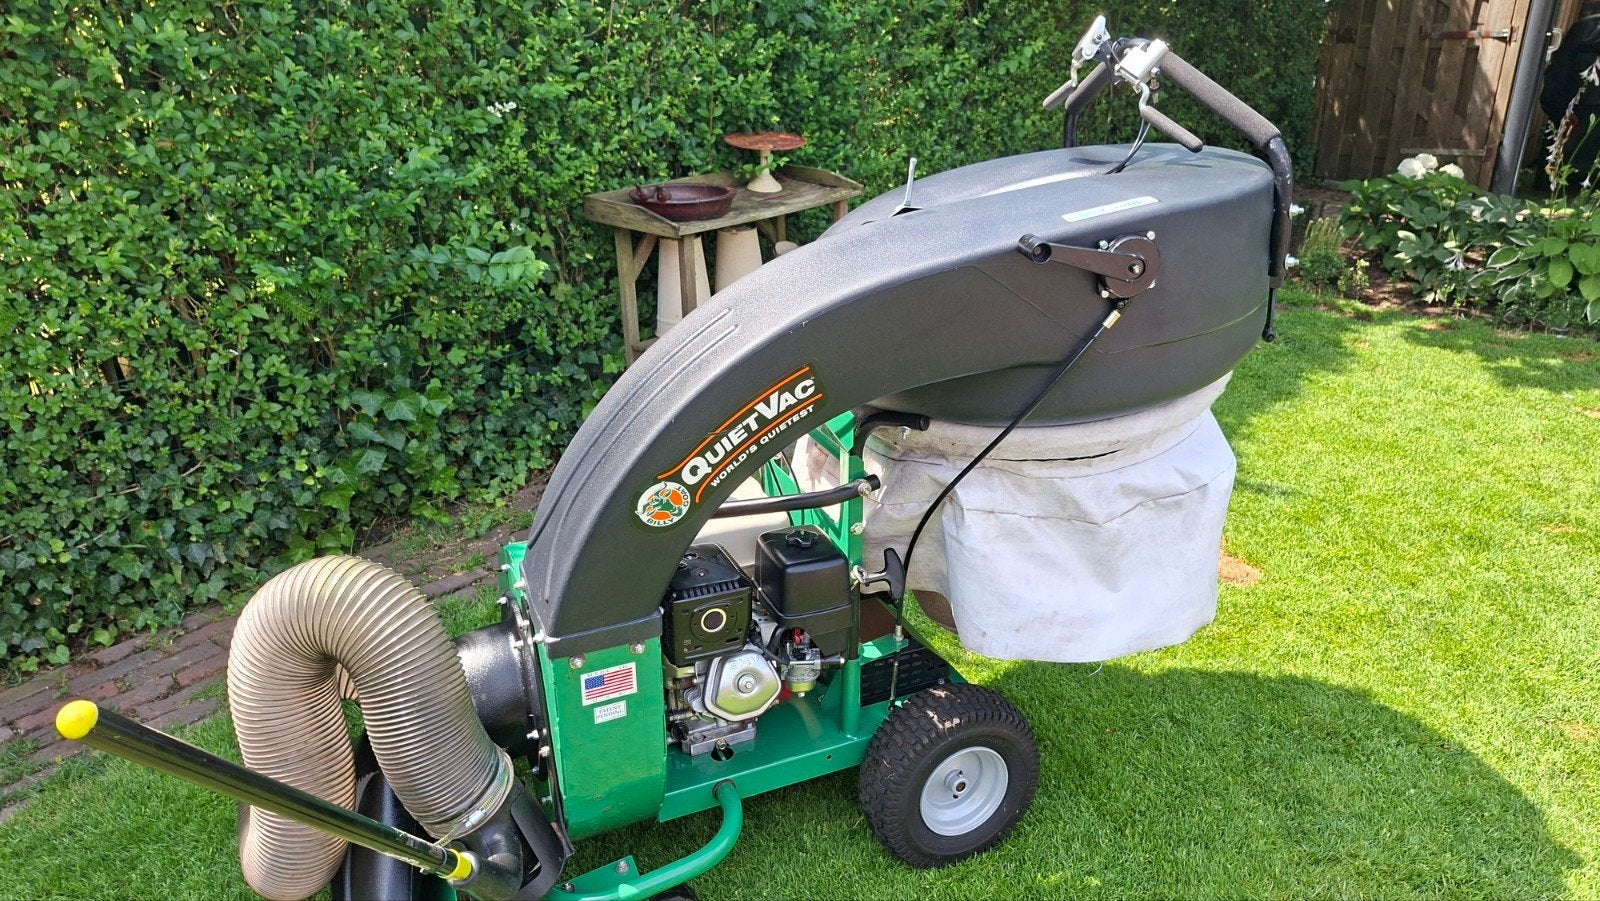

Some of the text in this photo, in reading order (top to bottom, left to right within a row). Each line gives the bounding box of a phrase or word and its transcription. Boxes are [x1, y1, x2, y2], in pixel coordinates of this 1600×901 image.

[710, 404, 815, 487] WORLD'S QUIETEST
[647, 486, 689, 526] BILLY GOAT
[599, 704, 621, 714] PATENT
